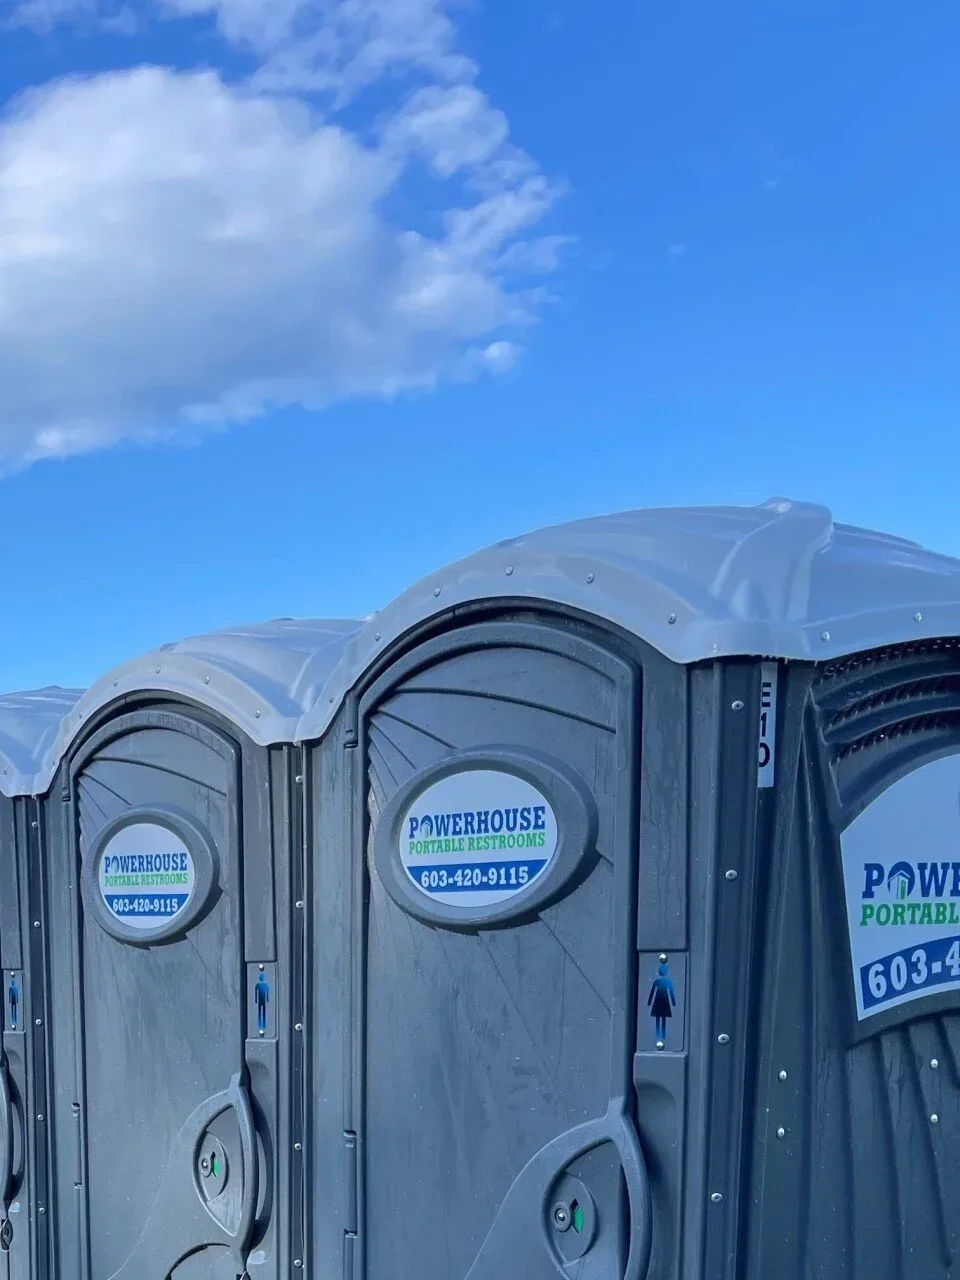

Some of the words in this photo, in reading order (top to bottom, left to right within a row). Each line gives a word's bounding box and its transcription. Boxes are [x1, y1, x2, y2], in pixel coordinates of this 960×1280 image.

[409, 806, 546, 839] POWERHOUSE
[409, 837, 465, 855] PORTABLE
[467, 832, 546, 852] RESTROOMS
[104, 853, 188, 873] POWERHOUSE
[105, 874, 140, 887] PORTABLE
[141, 872, 188, 886] RESTROOMS
[420, 866, 529, 888] 603-420-9115
[112, 898, 179, 912] 603-420-9115
